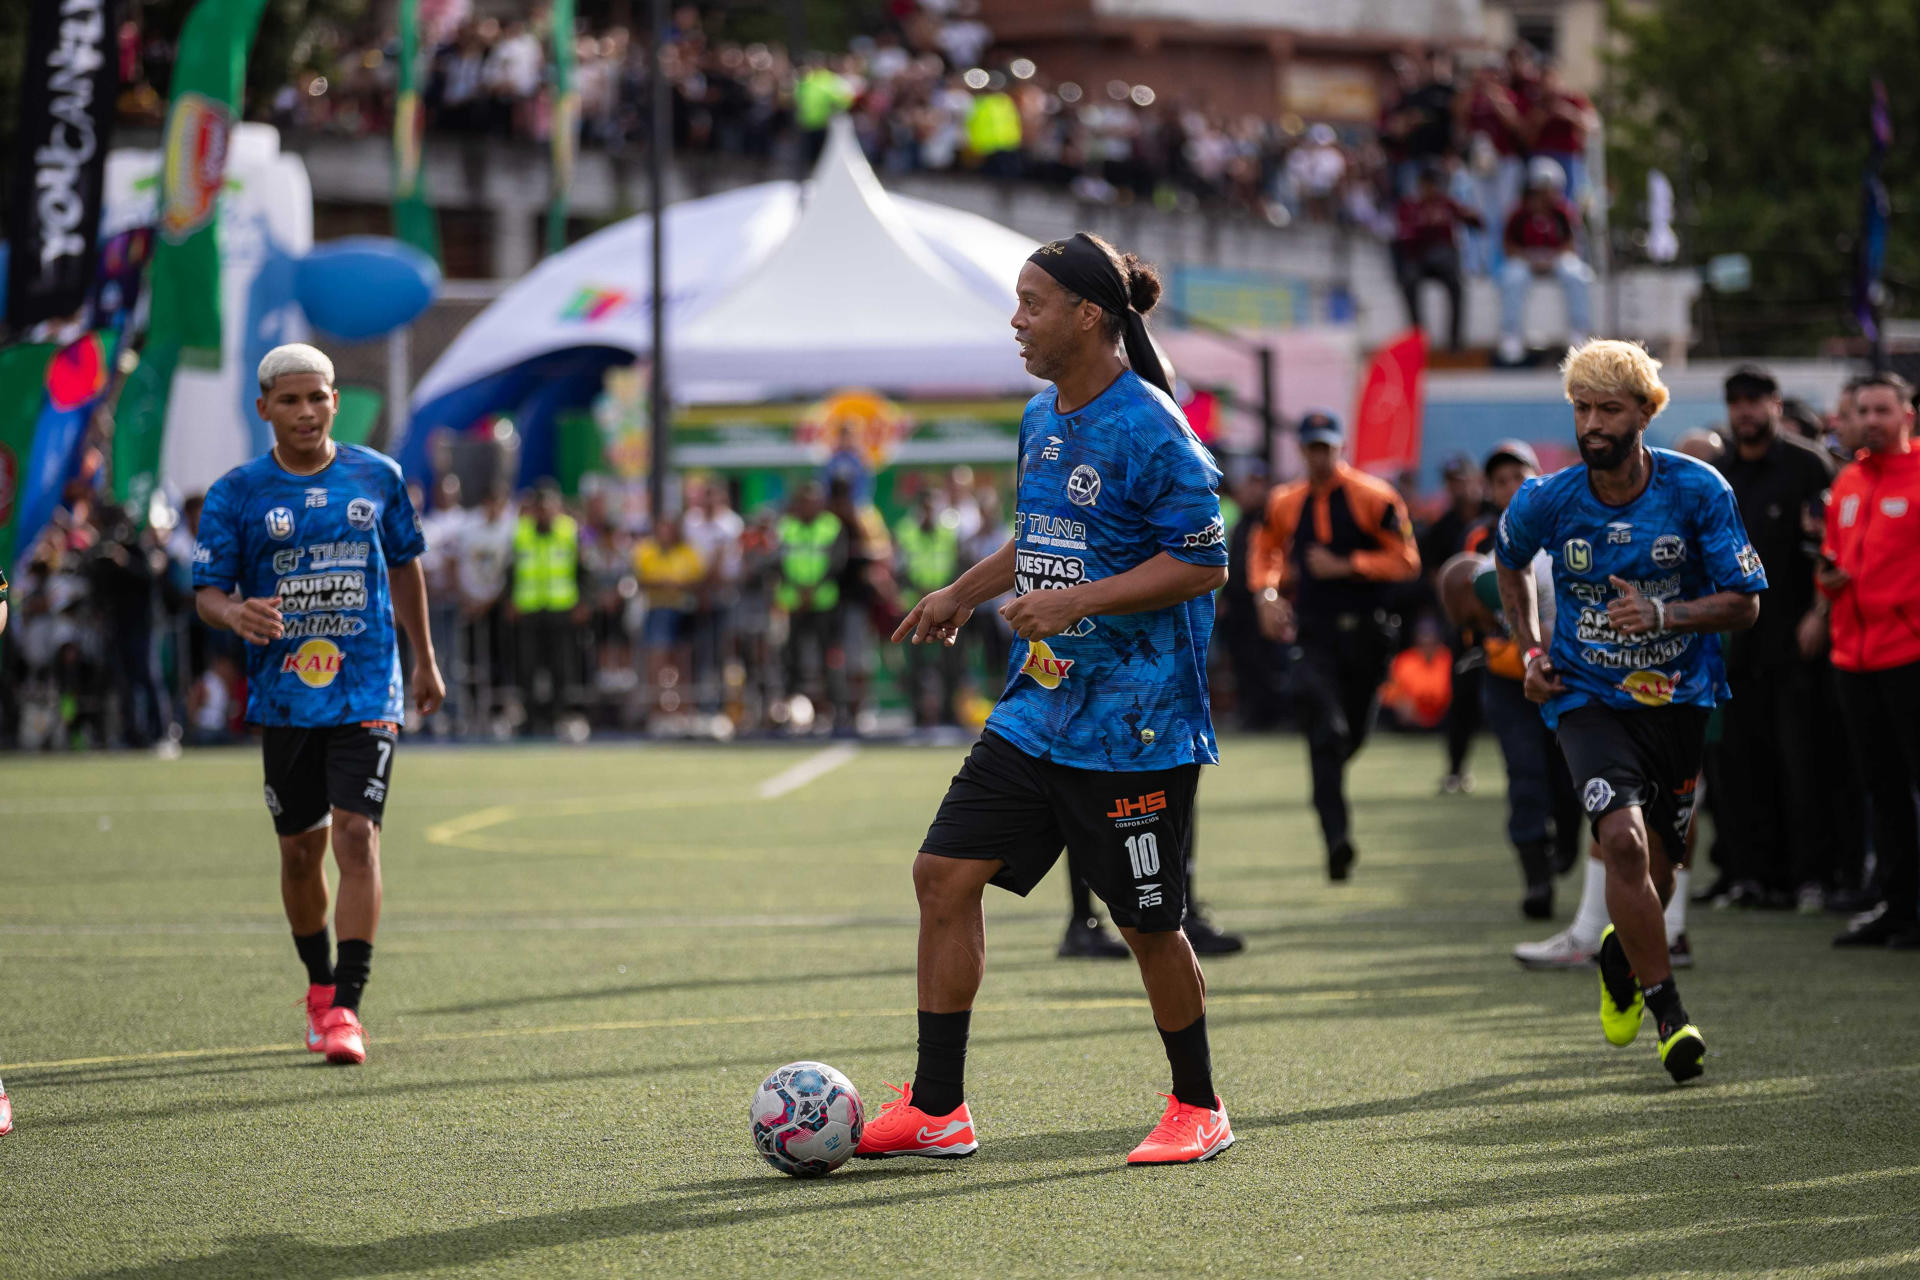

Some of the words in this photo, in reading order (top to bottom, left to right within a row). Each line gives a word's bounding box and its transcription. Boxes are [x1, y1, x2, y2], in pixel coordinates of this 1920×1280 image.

[1041, 446, 1061, 461] RS
[1028, 513, 1087, 541] TIUNA
[1606, 531, 1633, 545] RS
[1017, 554, 1081, 580] UESTAS
[277, 591, 366, 611] OYAL.COM
[1021, 653, 1075, 679] ALY
[377, 740, 391, 778] 7
[1107, 790, 1167, 818] JHS
[1124, 832, 1161, 879] 10
[1138, 891, 1163, 910] RS
